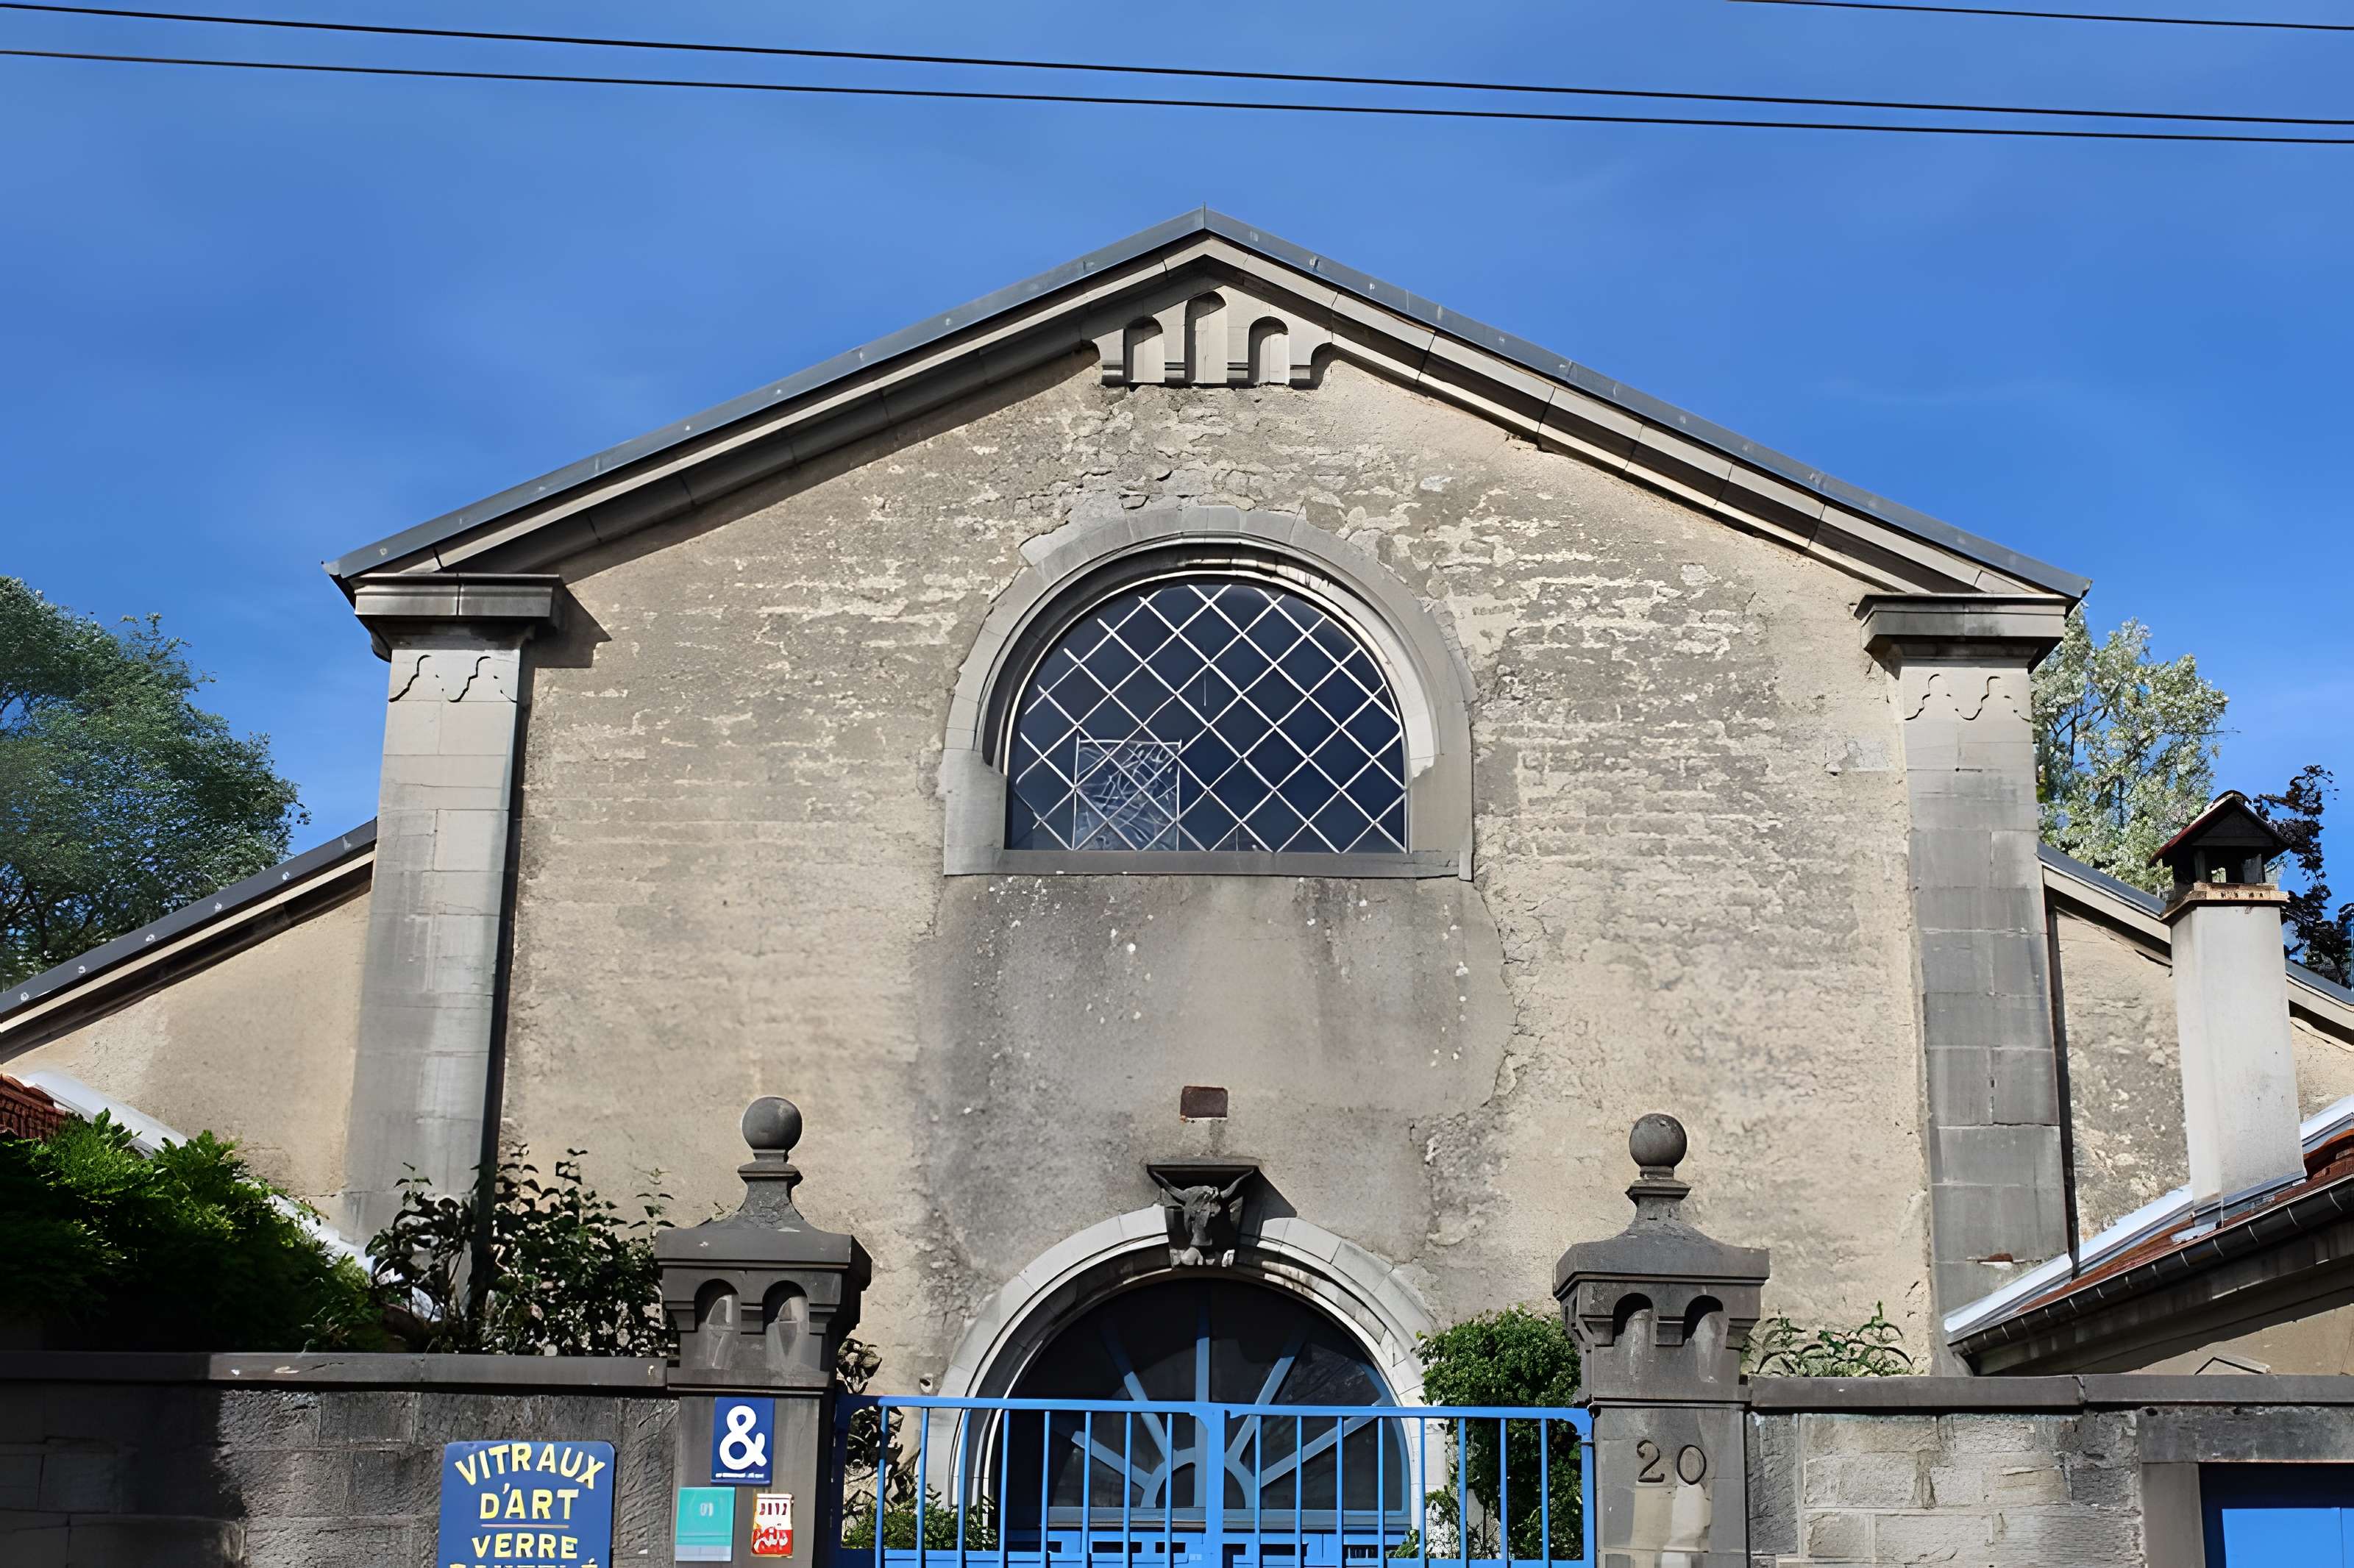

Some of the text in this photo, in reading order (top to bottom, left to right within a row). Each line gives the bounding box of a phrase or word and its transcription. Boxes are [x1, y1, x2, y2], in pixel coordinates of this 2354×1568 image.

[719, 1405, 767, 1470] &
[455, 1443, 605, 1489] VITRAUX
[1636, 1439, 1707, 1485] 20
[480, 1483, 579, 1519] D'ART
[472, 1533, 578, 1558] VERRE
